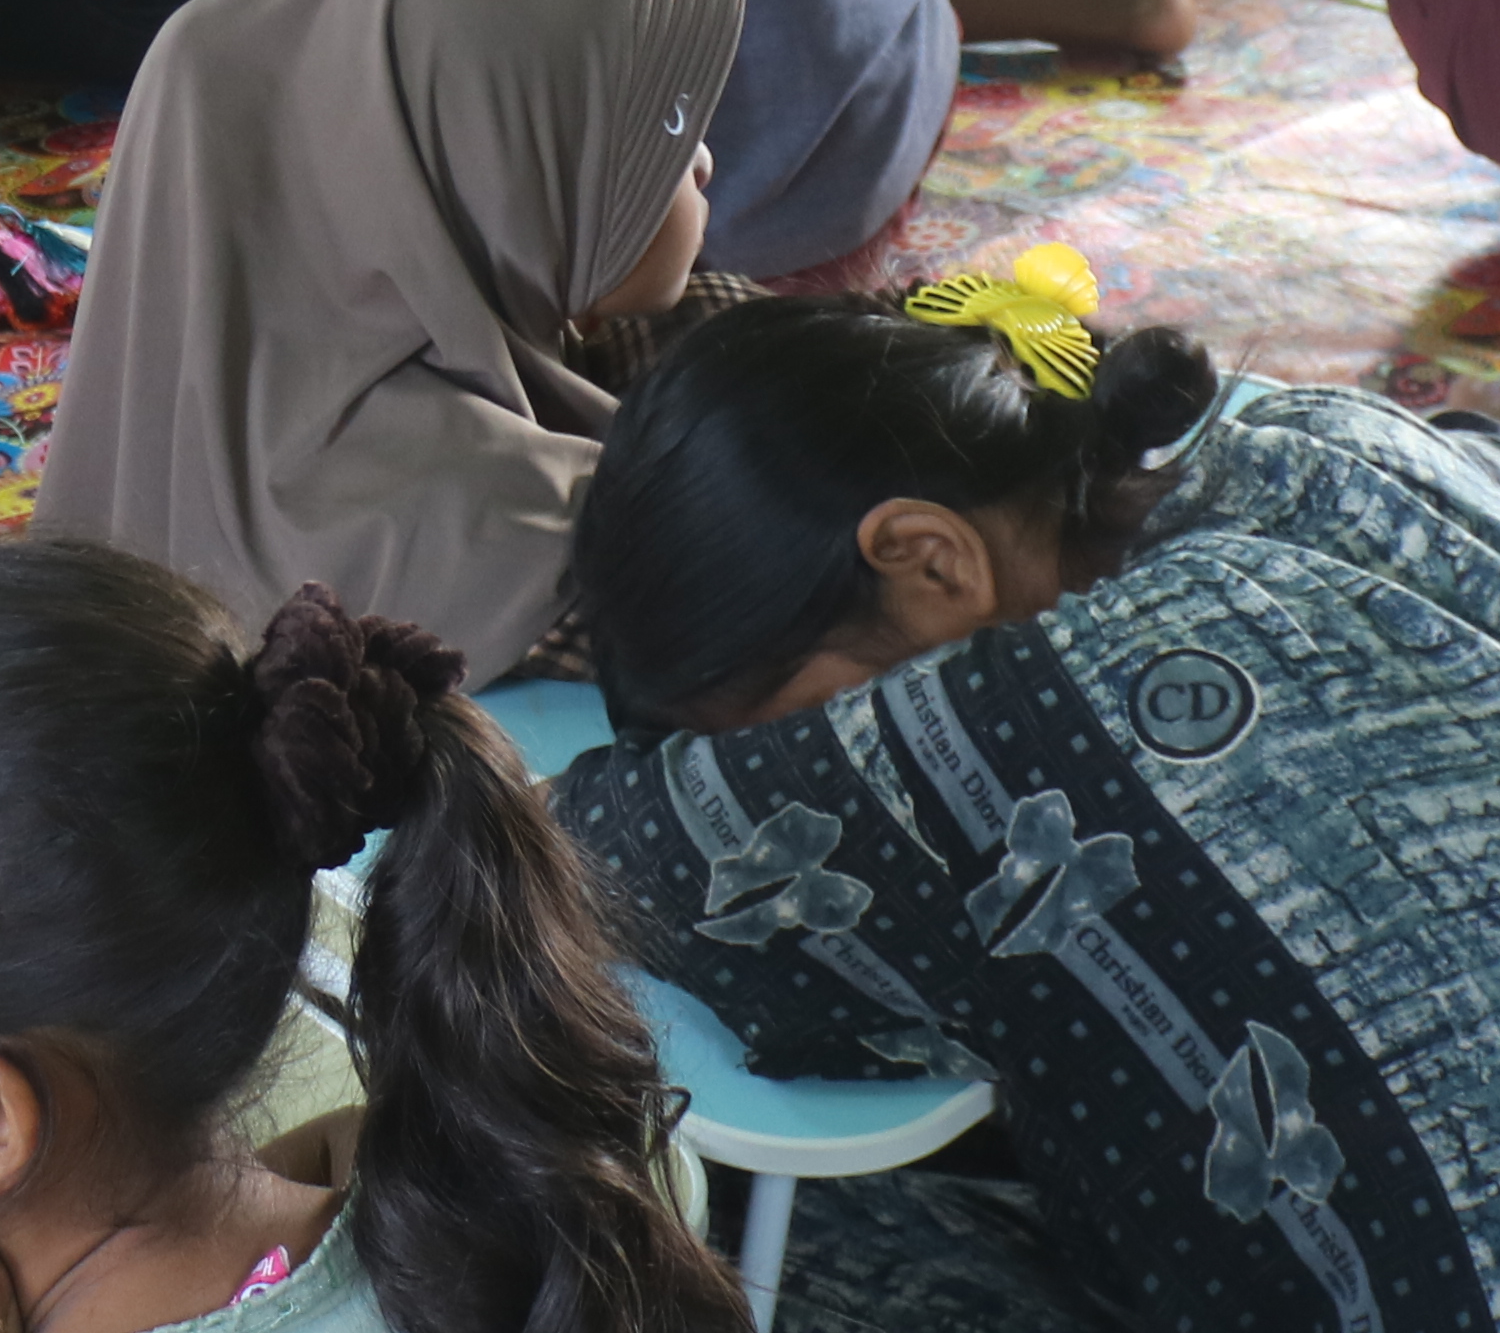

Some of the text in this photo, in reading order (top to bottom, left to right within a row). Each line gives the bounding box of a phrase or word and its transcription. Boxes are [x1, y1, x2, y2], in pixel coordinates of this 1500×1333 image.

[1147, 682, 1230, 725] CD
[959, 769, 1004, 832] Dior
[1072, 925, 1176, 1038] Christian
